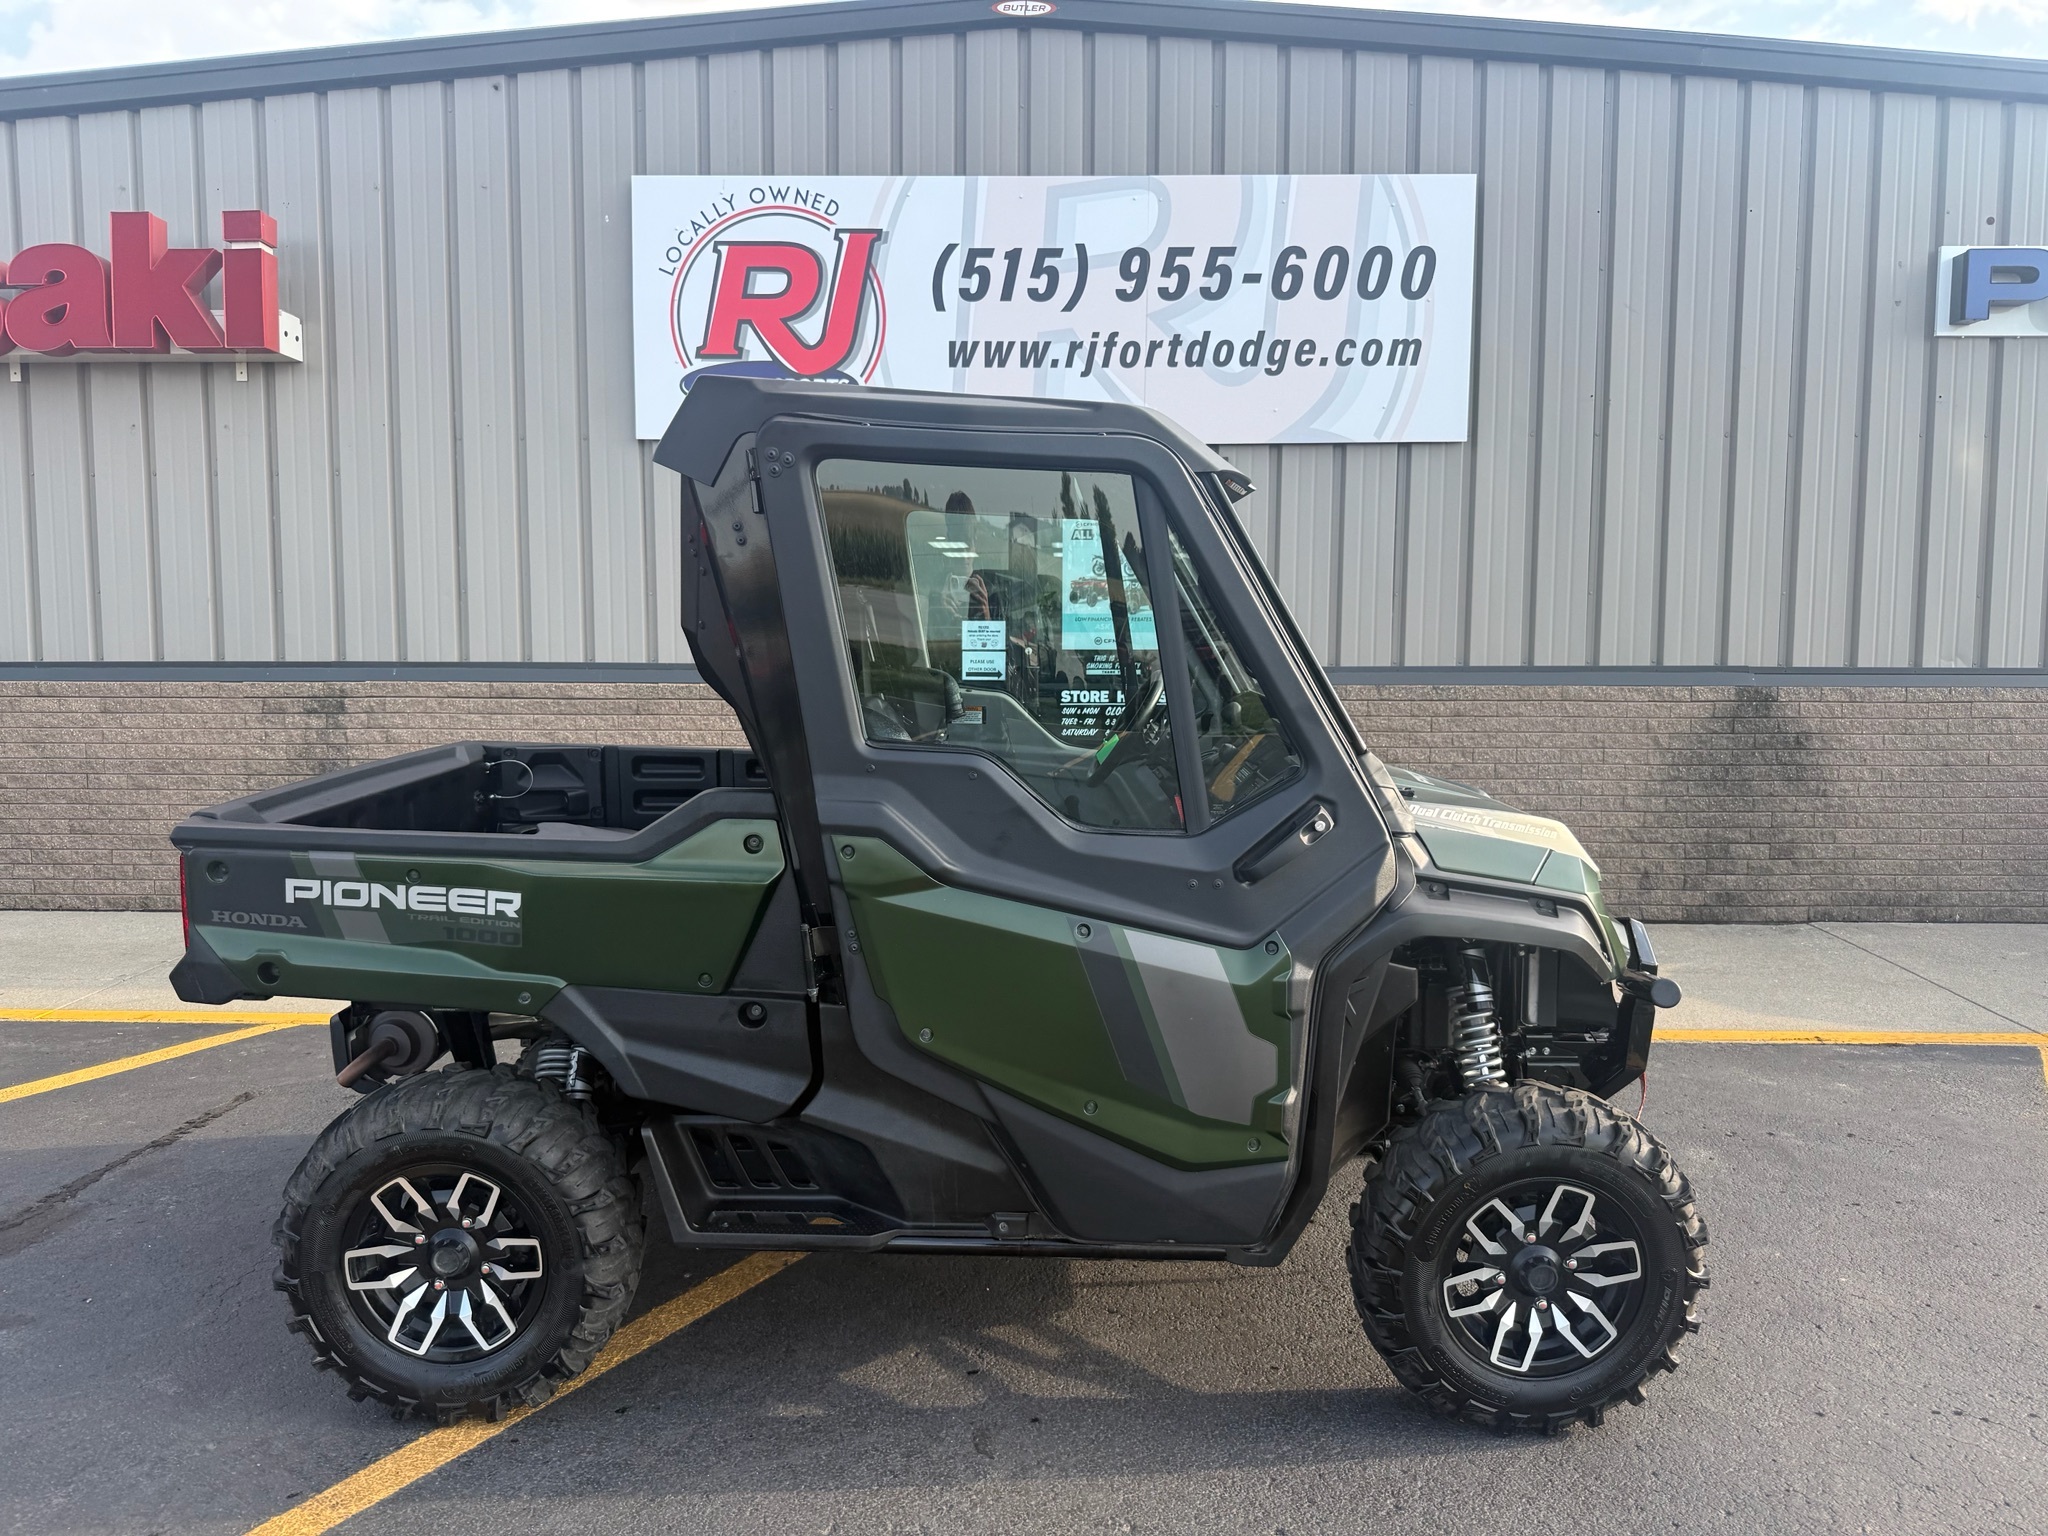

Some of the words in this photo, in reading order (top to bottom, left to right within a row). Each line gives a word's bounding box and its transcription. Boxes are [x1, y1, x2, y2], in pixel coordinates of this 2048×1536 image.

[1002, 4, 1047, 12] BUTLER
[658, 193, 736, 277] LOCALLY
[748, 185, 840, 218] OWNED
[0, 209, 278, 356] aki
[931, 243, 1089, 312] (515)
[1114, 245, 1438, 302] 955-6000
[694, 228, 888, 376] RJ
[948, 330, 1423, 378] www.rjfortdodge.com
[1060, 690, 1109, 703] STORE
[1061, 707, 1076, 715] SUN
[1081, 707, 1100, 715] MON
[1061, 718, 1079, 726] TUES
[1083, 718, 1097, 726] FRI
[1060, 728, 1098, 737] SATURDAY
[1408, 804, 1440, 818] Dual
[1440, 809, 1482, 825] Clutch
[1482, 816, 1558, 840] Transmission
[284, 877, 522, 918] PIONEER
[210, 909, 307, 929] HONDA
[407, 913, 456, 923] TRAIL
[458, 917, 522, 929] EDITION
[442, 926, 522, 945] 1000
